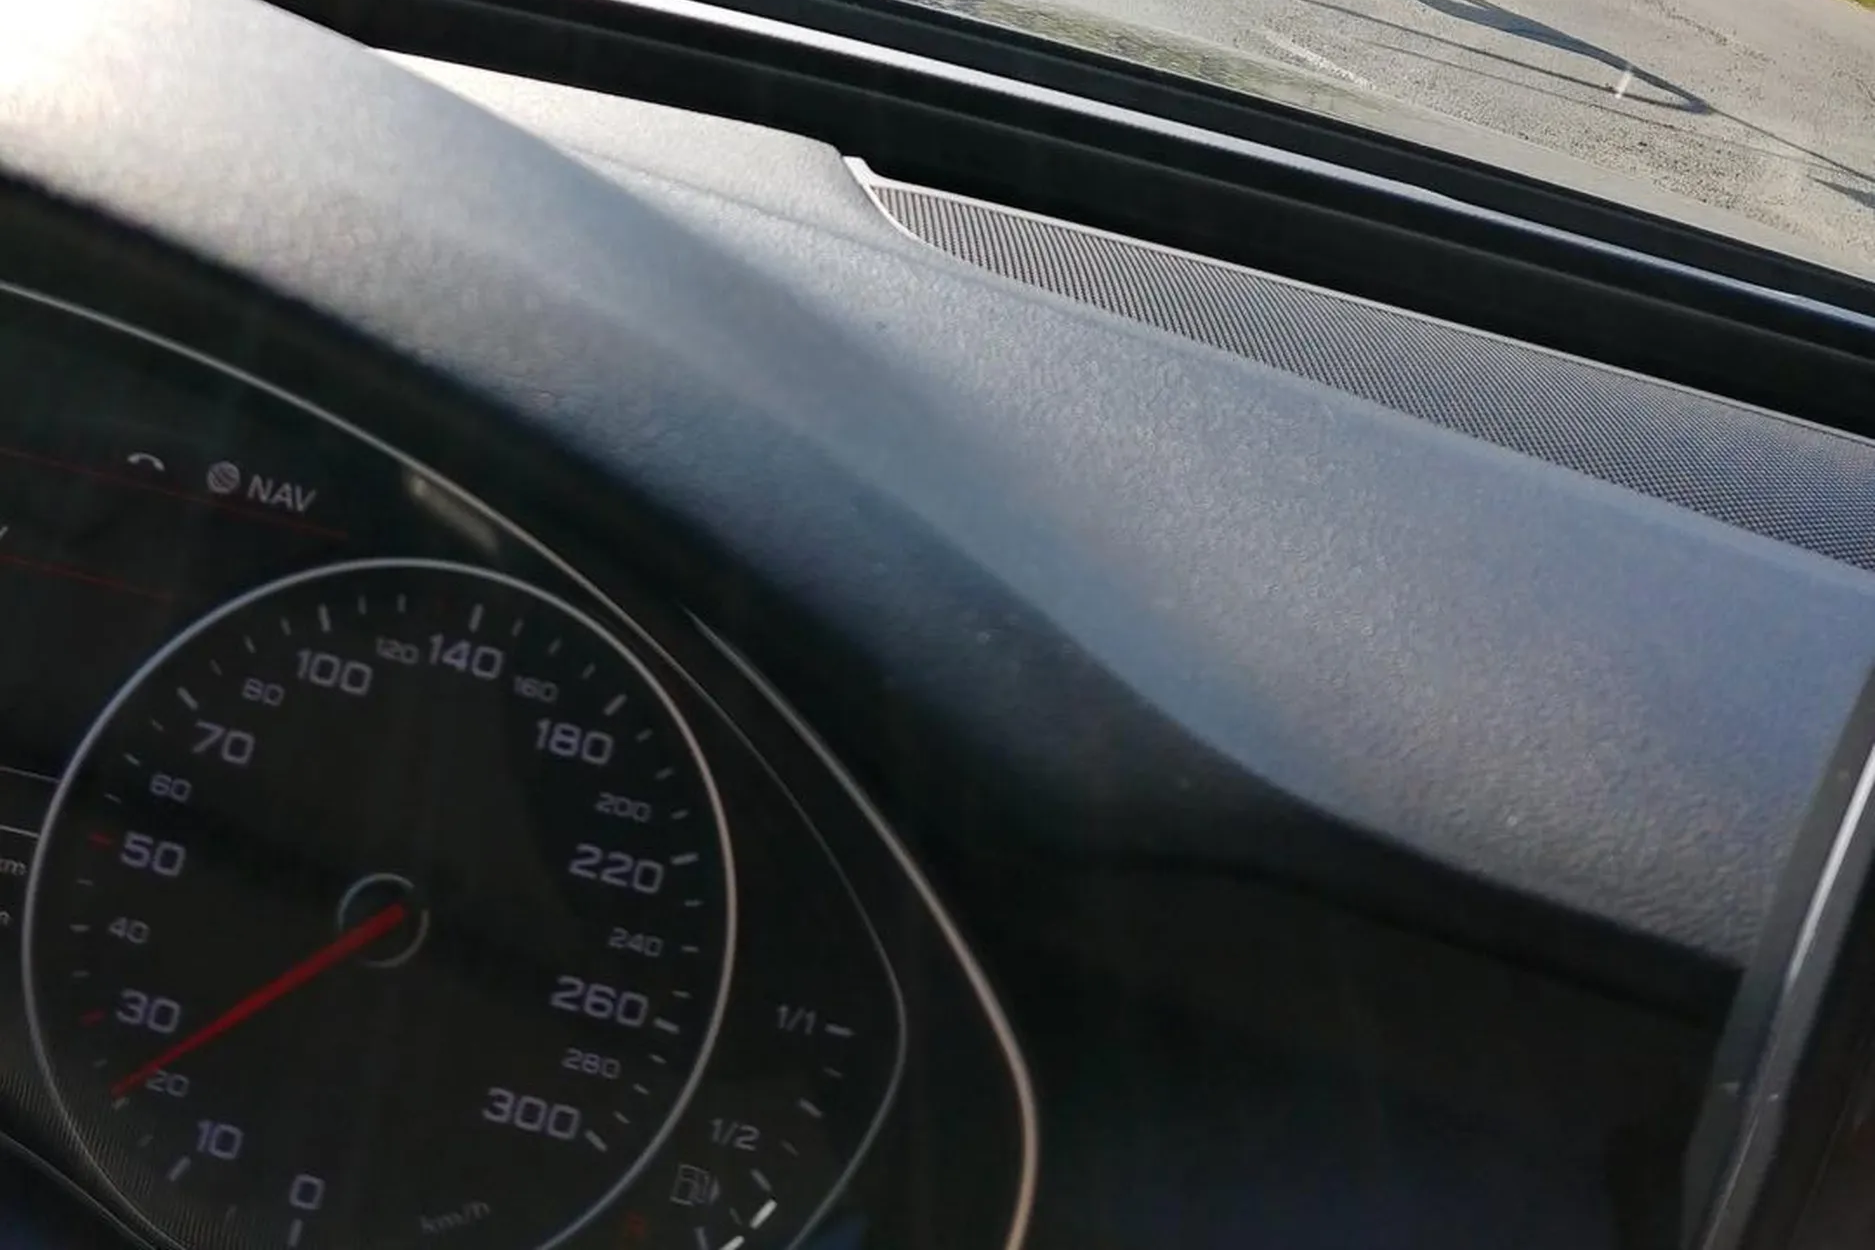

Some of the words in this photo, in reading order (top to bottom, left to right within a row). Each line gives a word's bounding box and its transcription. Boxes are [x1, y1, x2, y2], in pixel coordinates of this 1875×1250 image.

[247, 473, 317, 513] NAV
[375, 636, 420, 665] 120
[429, 633, 504, 680] 140
[296, 647, 374, 696] 100
[192, 718, 256, 766] 70
[535, 718, 616, 765] 180
[594, 791, 652, 824] 200
[119, 830, 187, 878] 50
[568, 843, 665, 894] 220
[107, 916, 151, 944] 40
[607, 926, 664, 958] 240
[115, 988, 181, 1034] 30
[549, 975, 650, 1028] 260
[776, 1004, 818, 1035] 1/1
[144, 1069, 190, 1098] 20
[561, 1047, 622, 1080] 280
[482, 1087, 582, 1141] 300
[196, 1119, 245, 1160] 10
[710, 1118, 760, 1151] 1/2
[288, 1173, 326, 1210] 0
